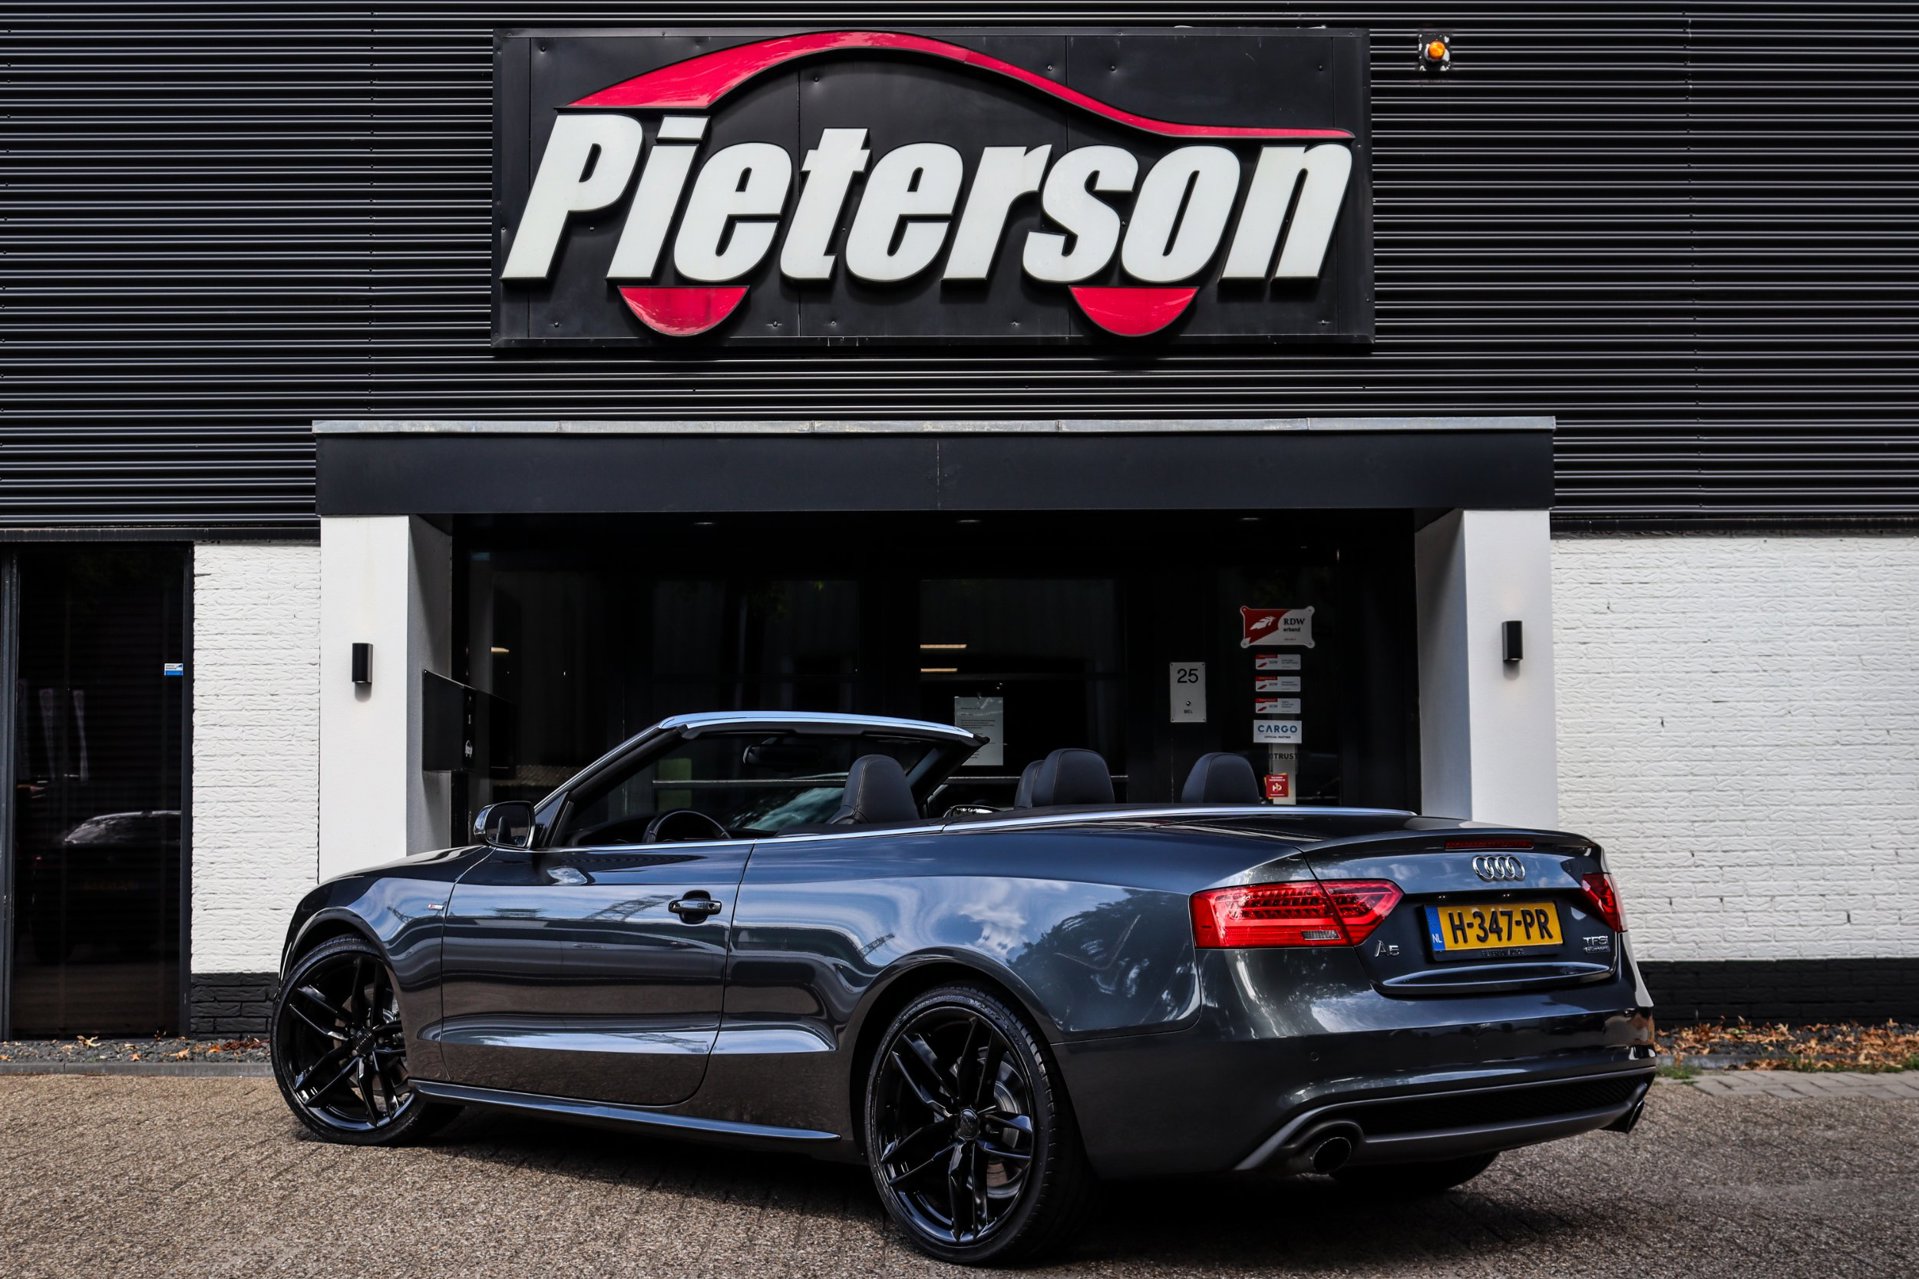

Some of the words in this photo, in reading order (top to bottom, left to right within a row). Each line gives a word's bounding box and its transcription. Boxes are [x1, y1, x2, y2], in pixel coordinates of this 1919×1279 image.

[501, 113, 1354, 283] Pieterson
[1283, 617, 1306, 626] RDW
[1177, 668, 1199, 683] 25
[1257, 724, 1298, 734] CARGO
[1448, 908, 1554, 945] H-347-PR
[1432, 934, 1443, 944] NL
[1374, 940, 1399, 957] A5
